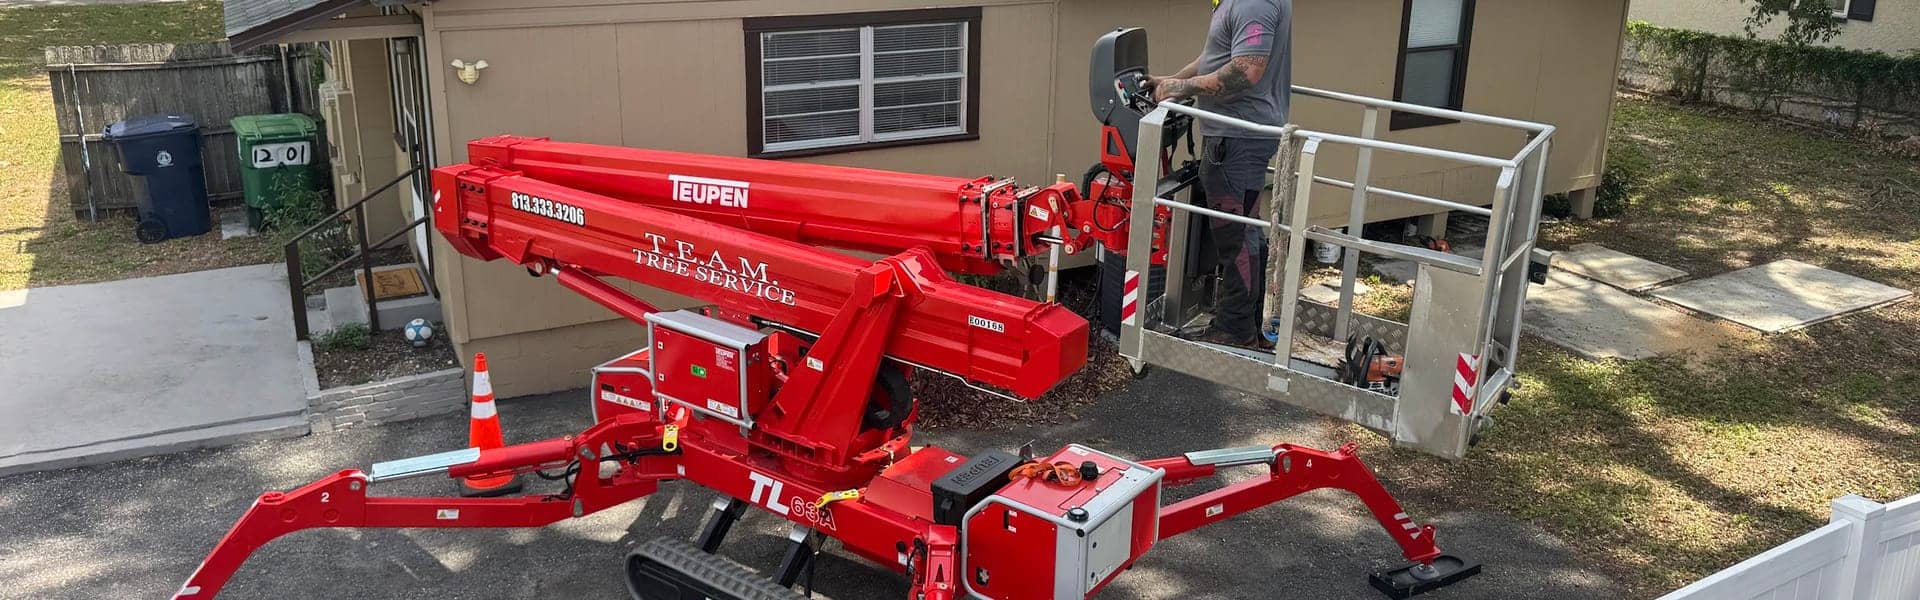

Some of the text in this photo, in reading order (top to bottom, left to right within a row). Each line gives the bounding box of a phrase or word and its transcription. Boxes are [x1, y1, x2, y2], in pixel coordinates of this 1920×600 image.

[511, 191, 585, 226] 813.333.3206
[668, 174, 750, 209] TEUPEN
[644, 232, 779, 286] T.E.A.M.
[632, 248, 796, 306] TREE SERVICE
[1306, 458, 1313, 468] 4
[320, 492, 330, 502] 2
